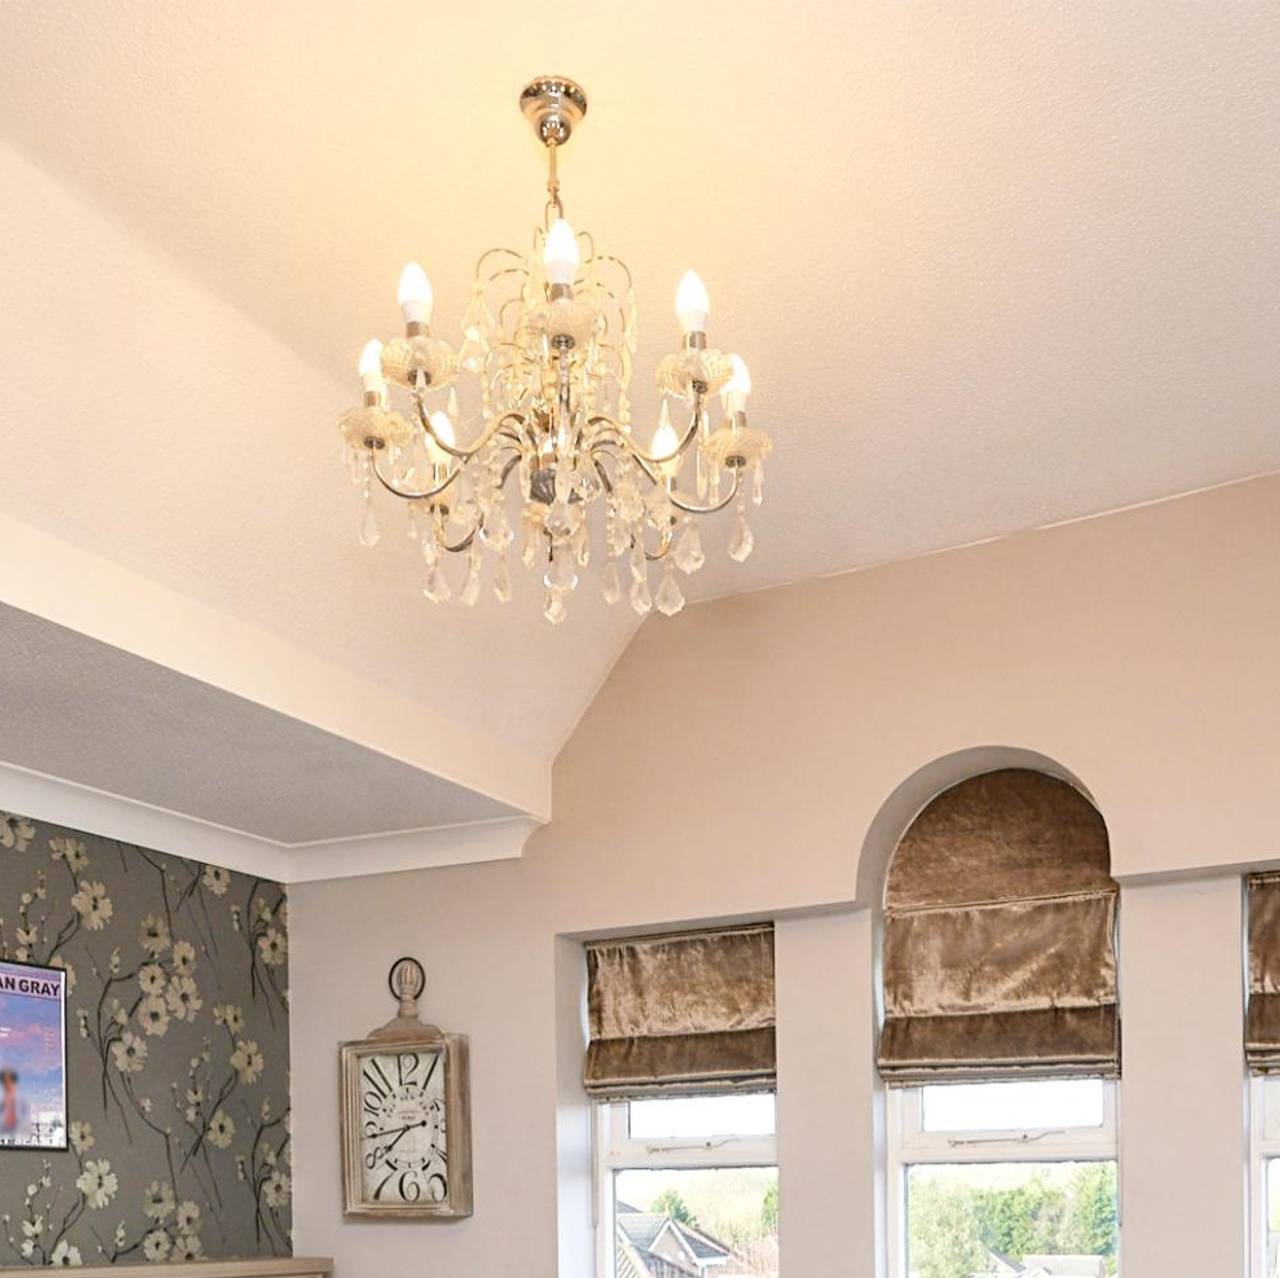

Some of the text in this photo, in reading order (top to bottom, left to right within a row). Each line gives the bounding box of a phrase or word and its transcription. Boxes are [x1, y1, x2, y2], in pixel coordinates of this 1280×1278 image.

[18, 979, 60, 997] GRAY
[363, 1090, 383, 1118] 10
[365, 1146, 385, 1170] 8
[373, 1159, 398, 1200] 7
[399, 1170, 421, 1202] 6
